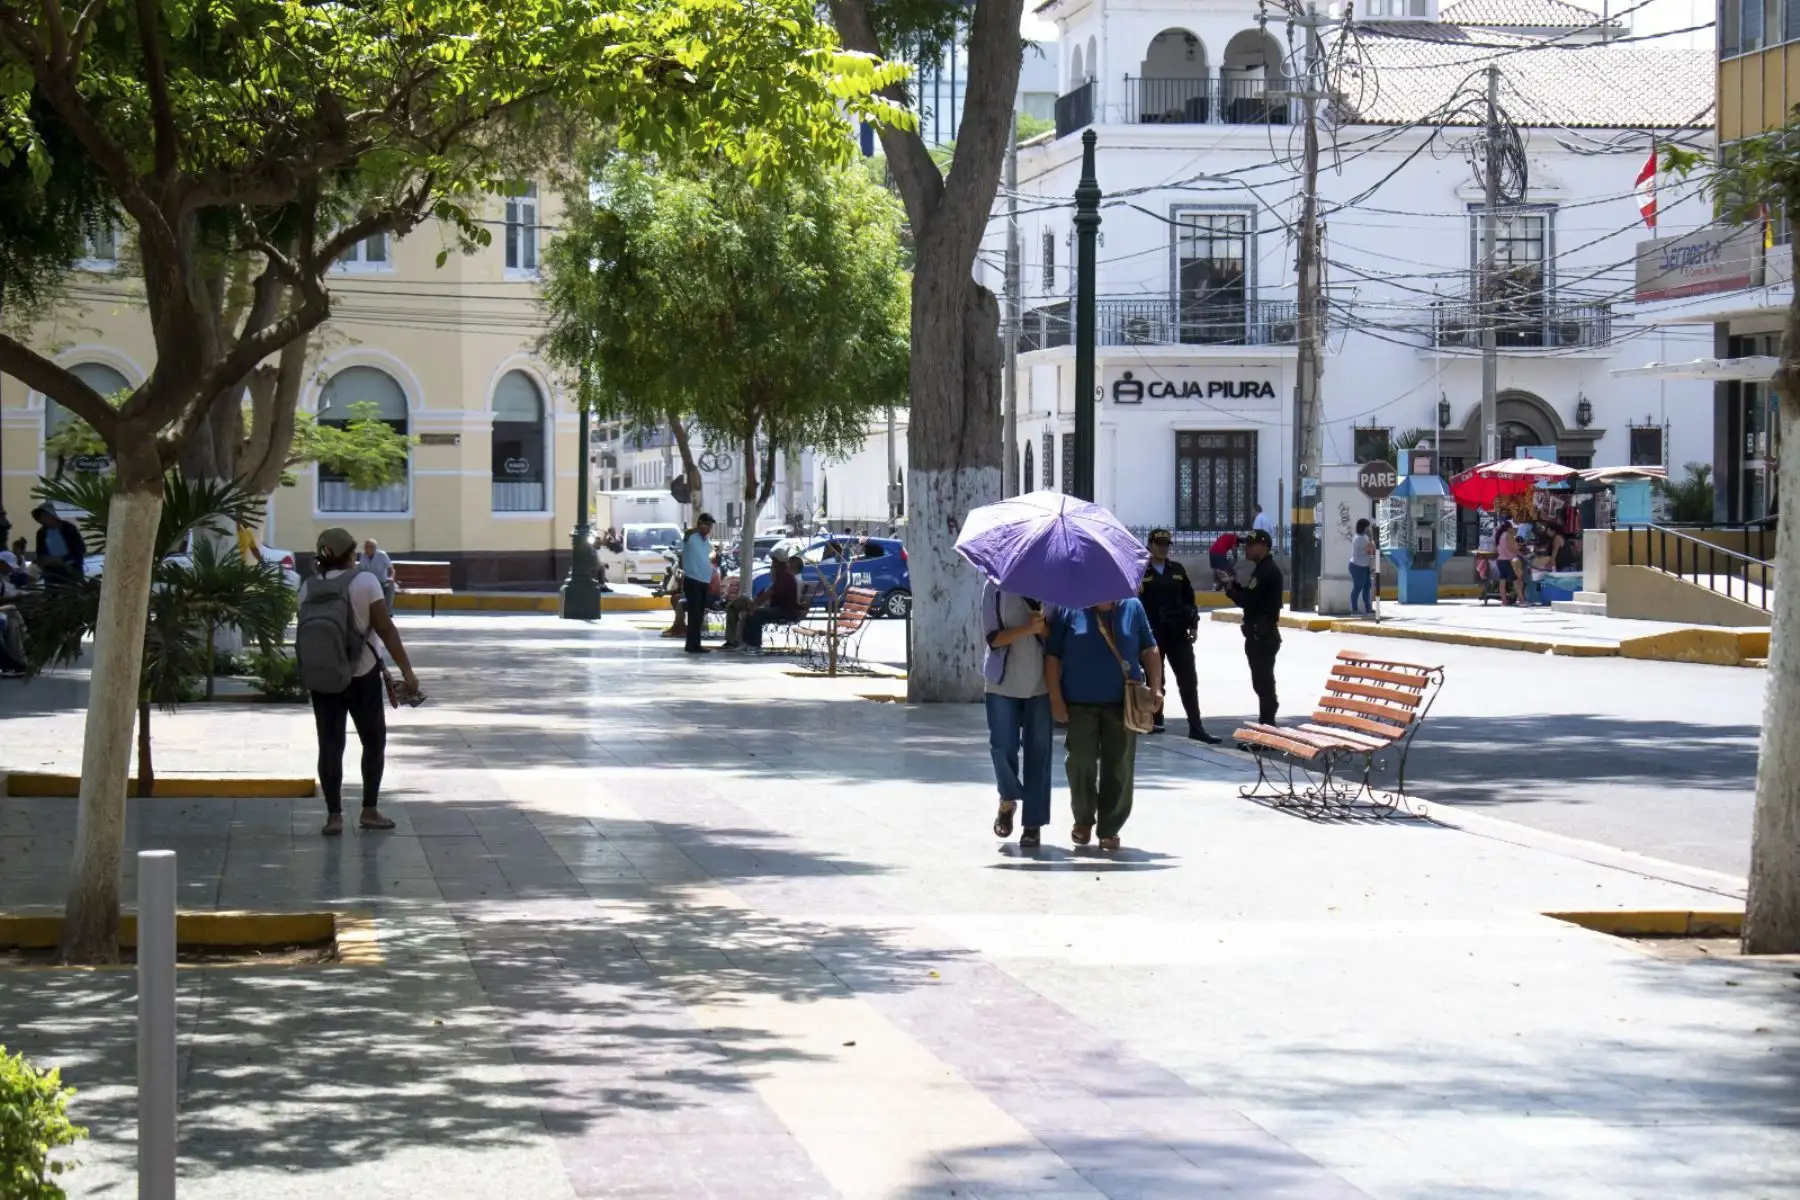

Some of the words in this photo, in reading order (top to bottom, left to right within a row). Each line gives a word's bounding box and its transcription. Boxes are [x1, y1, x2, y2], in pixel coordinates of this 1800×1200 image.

[1148, 381, 1203, 398] CAJA
[1207, 381, 1276, 398] PIURA
[1360, 472, 1396, 488] PARE
